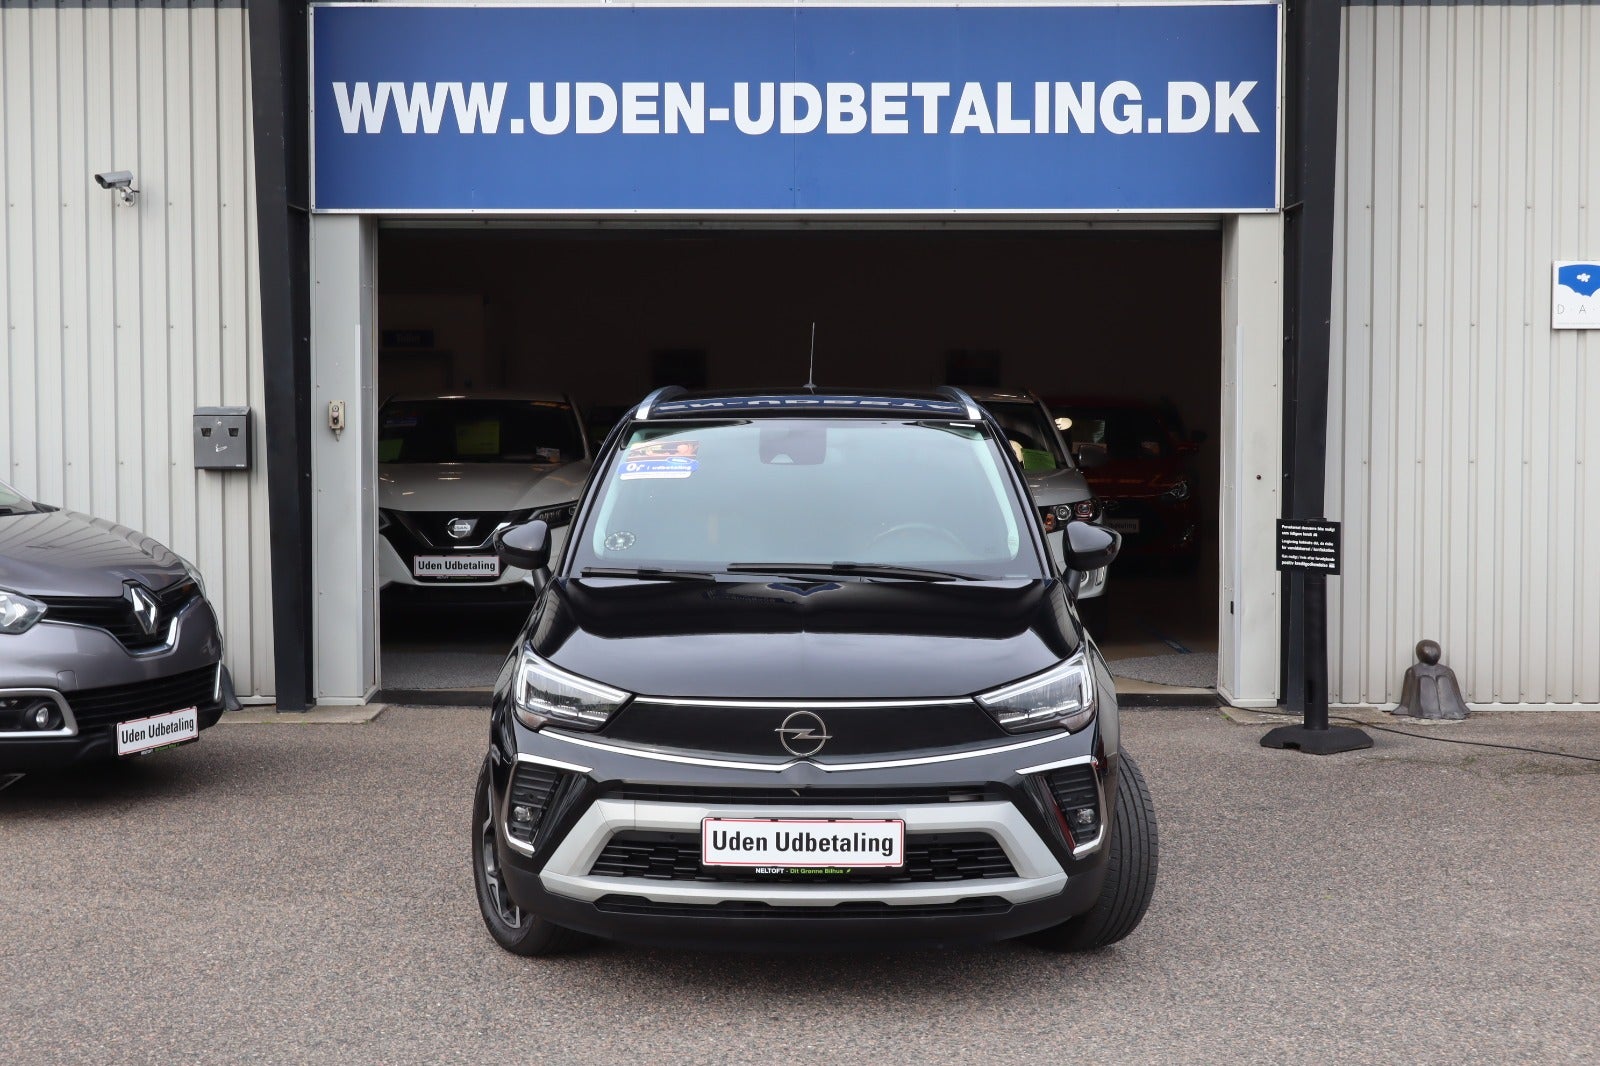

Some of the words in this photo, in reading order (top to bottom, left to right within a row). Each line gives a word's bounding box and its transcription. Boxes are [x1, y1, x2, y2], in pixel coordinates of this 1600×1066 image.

[332, 80, 1260, 135] WWW.UDEN-UDBETALING.DK
[418, 560, 442, 571] Uden
[445, 560, 496, 572] Udbetaling
[121, 728, 146, 744] Uden
[148, 717, 194, 739] Udbetaling
[712, 830, 768, 851] Uden
[775, 831, 894, 857] Udbetaling
